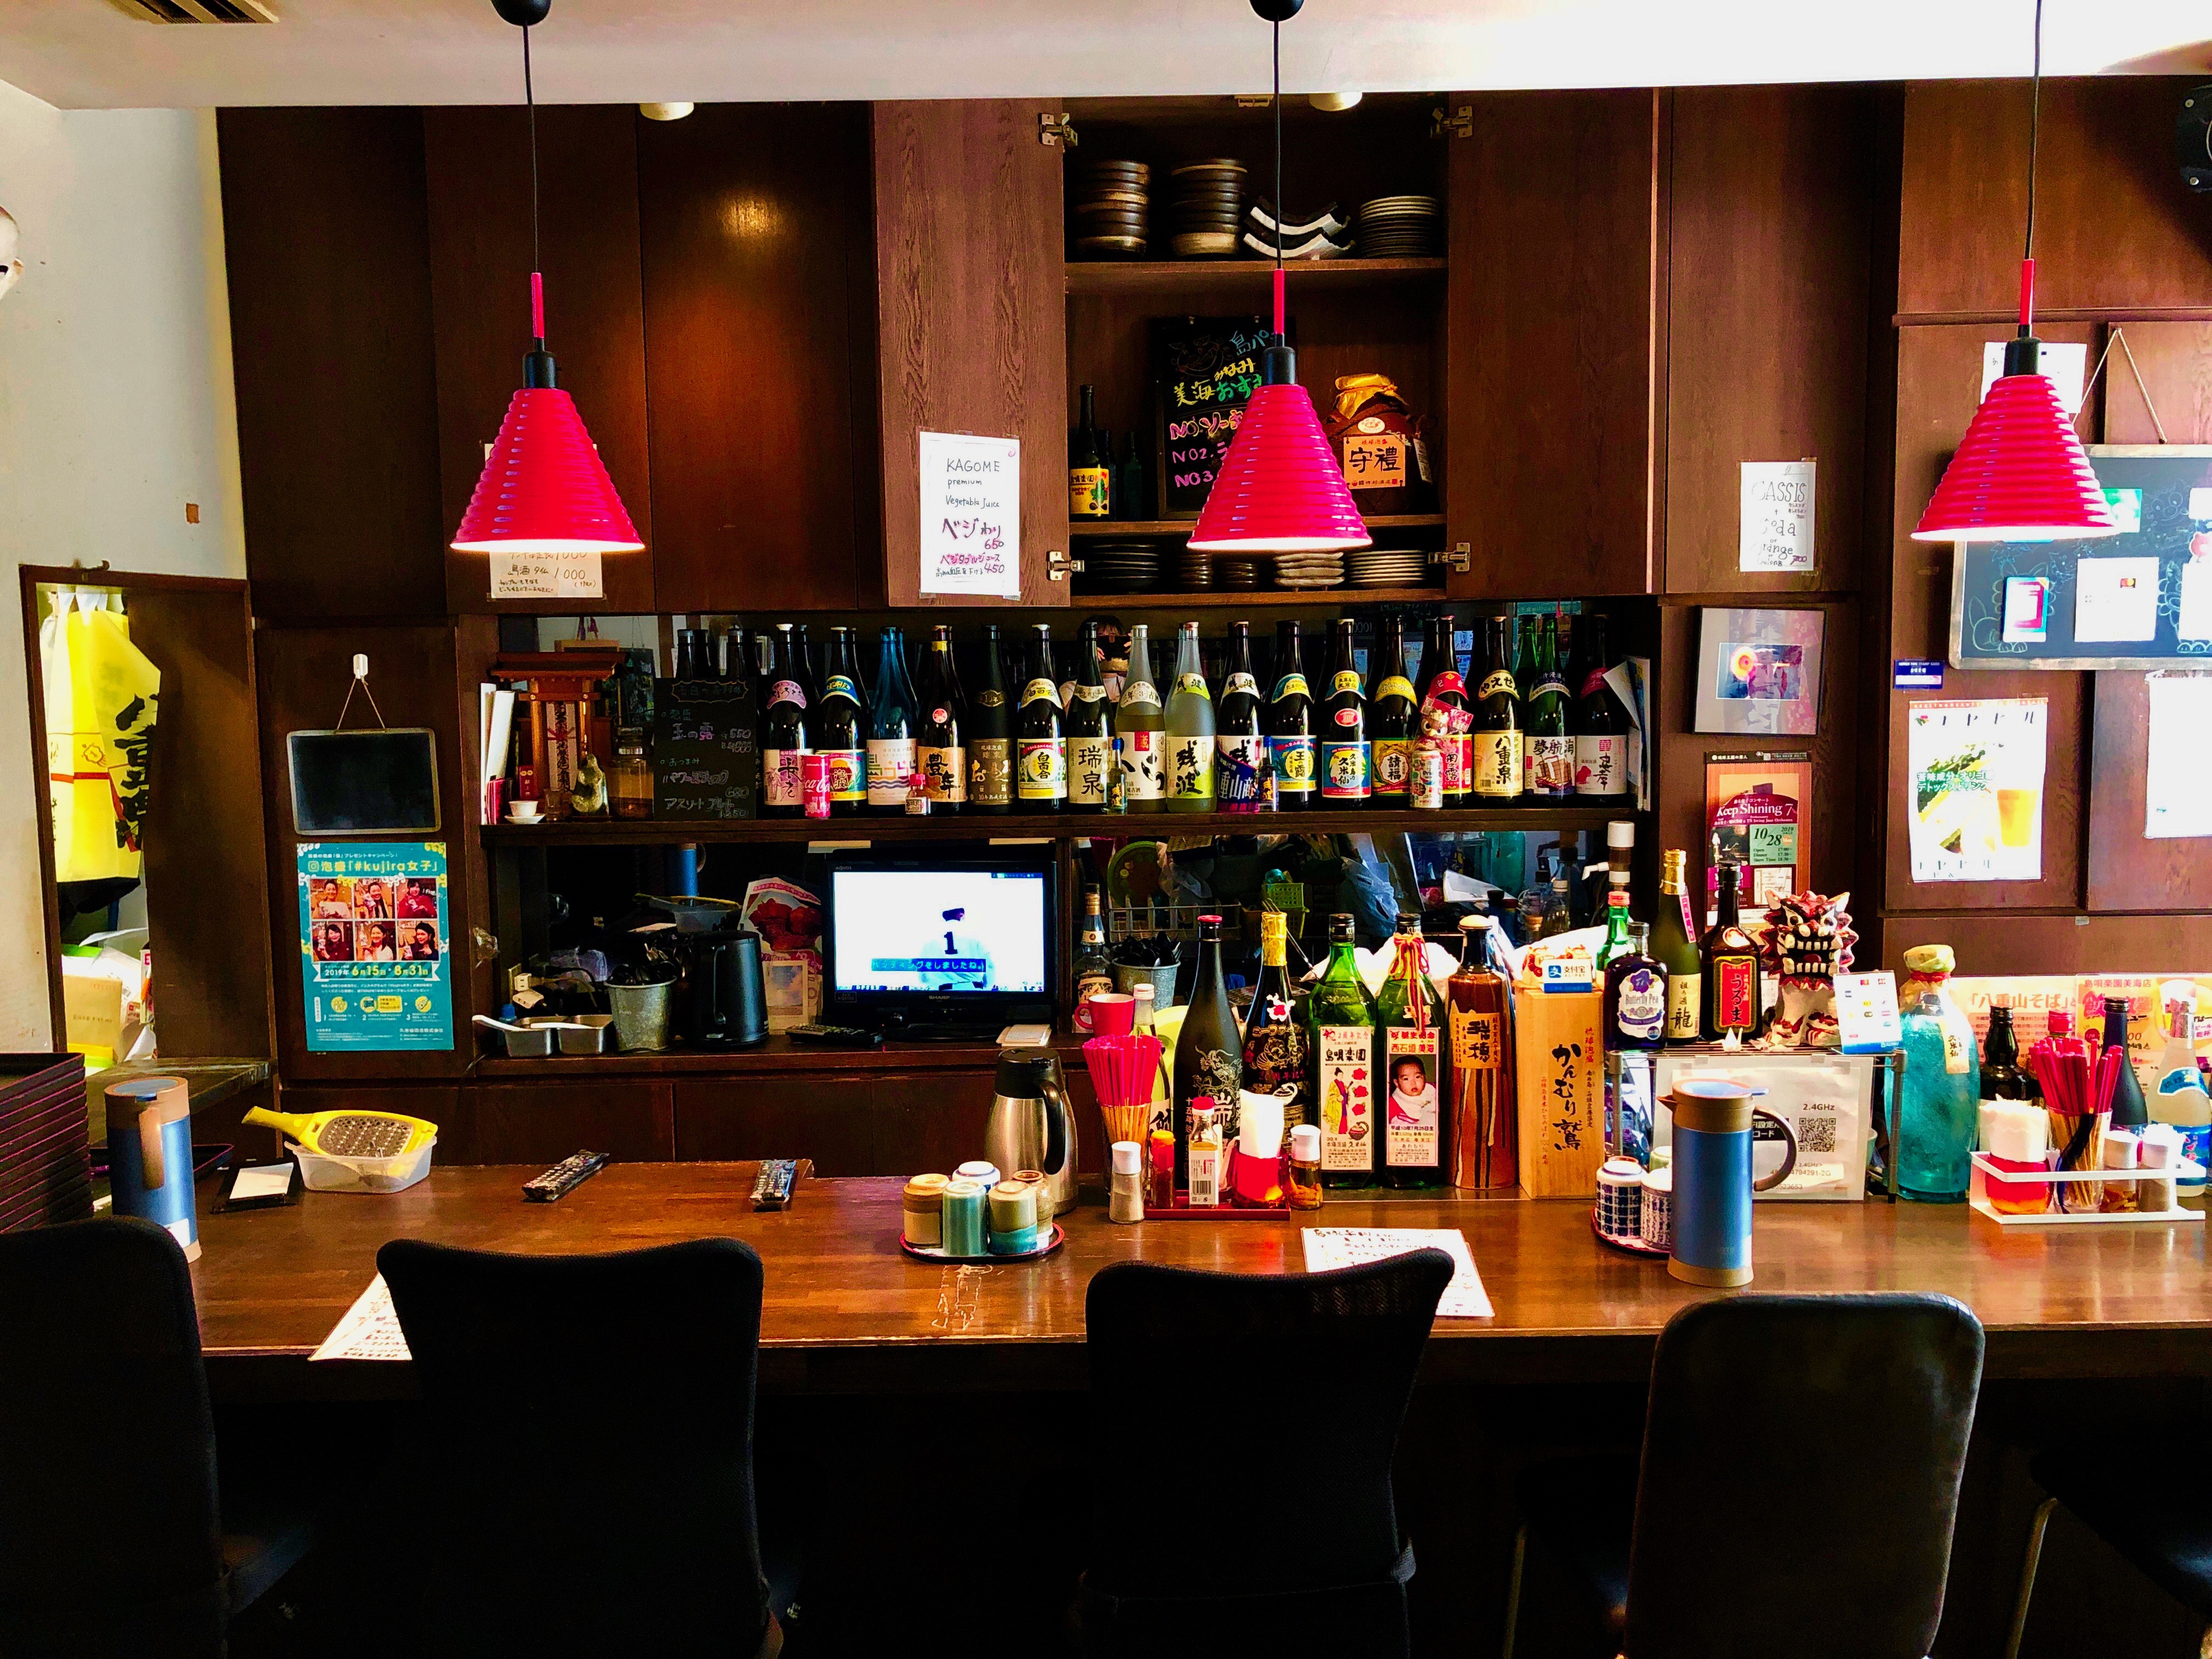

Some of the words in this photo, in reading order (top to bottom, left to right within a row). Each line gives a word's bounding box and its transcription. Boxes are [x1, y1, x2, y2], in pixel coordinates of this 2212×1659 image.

[1173, 380, 1214, 407] 美海
[946, 458, 1000, 472] KAGOME
[947, 479, 982, 489] premium
[1752, 481, 1807, 503] CASSIS
[946, 495, 979, 507] Vegetable
[942, 517, 1001, 539] ベジわり
[984, 539, 1005, 550] 650
[984, 563, 1005, 574] 450
[1790, 555, 1807, 565] 700
[1036, 751, 1050, 779] 白百合
[1078, 744, 1104, 795] 瑞泉
[1176, 740, 1203, 795] 残波
[1387, 755, 1401, 780] 請福
[1445, 753, 1458, 781] 菊之露
[1496, 735, 1511, 785] 八重泉
[834, 769, 847, 789] 泡波
[1338, 758, 1349, 785] 久米仙
[1917, 782, 1987, 792] デトックスドリンク
[1716, 806, 1739, 817] Keep
[1740, 803, 1782, 816] Shining
[1785, 804, 1794, 816] 7
[944, 932, 957, 955] 1
[2084, 979, 2152, 988] 島唄楽園美海店
[1625, 994, 1647, 1006] Butterfly
[1649, 994, 1658, 1004] Pea
[1730, 973, 1742, 1022] うるま
[1670, 1006, 1693, 1030] 龍
[1325, 1046, 1366, 1062] 島唄楽園
[1948, 1035, 1959, 1058] 久米仙
[1552, 1043, 1583, 1150] かんむり鷲
